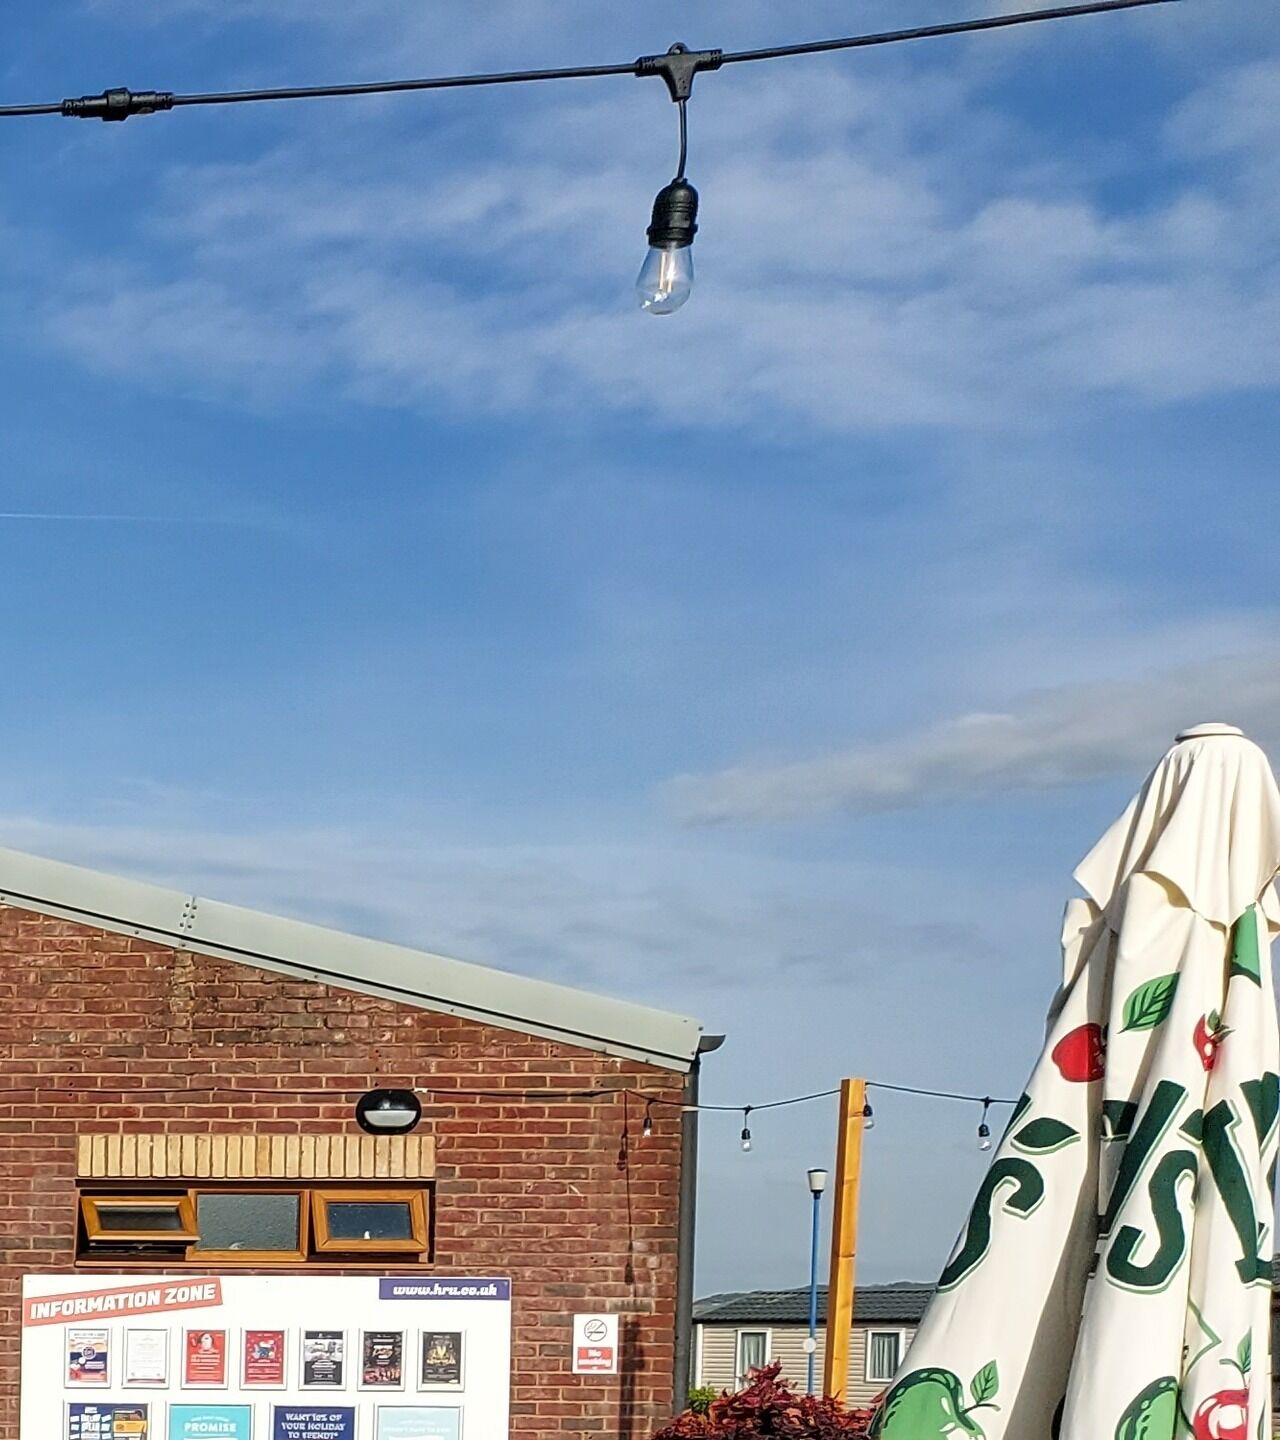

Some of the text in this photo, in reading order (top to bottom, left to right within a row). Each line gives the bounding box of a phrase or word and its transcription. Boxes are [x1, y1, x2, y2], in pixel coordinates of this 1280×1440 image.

[393, 1283, 497, 1296] www.hru.co.uk
[30, 1283, 217, 1320] INFORMATION ZONE
[184, 1422, 236, 1432] PROMISE
